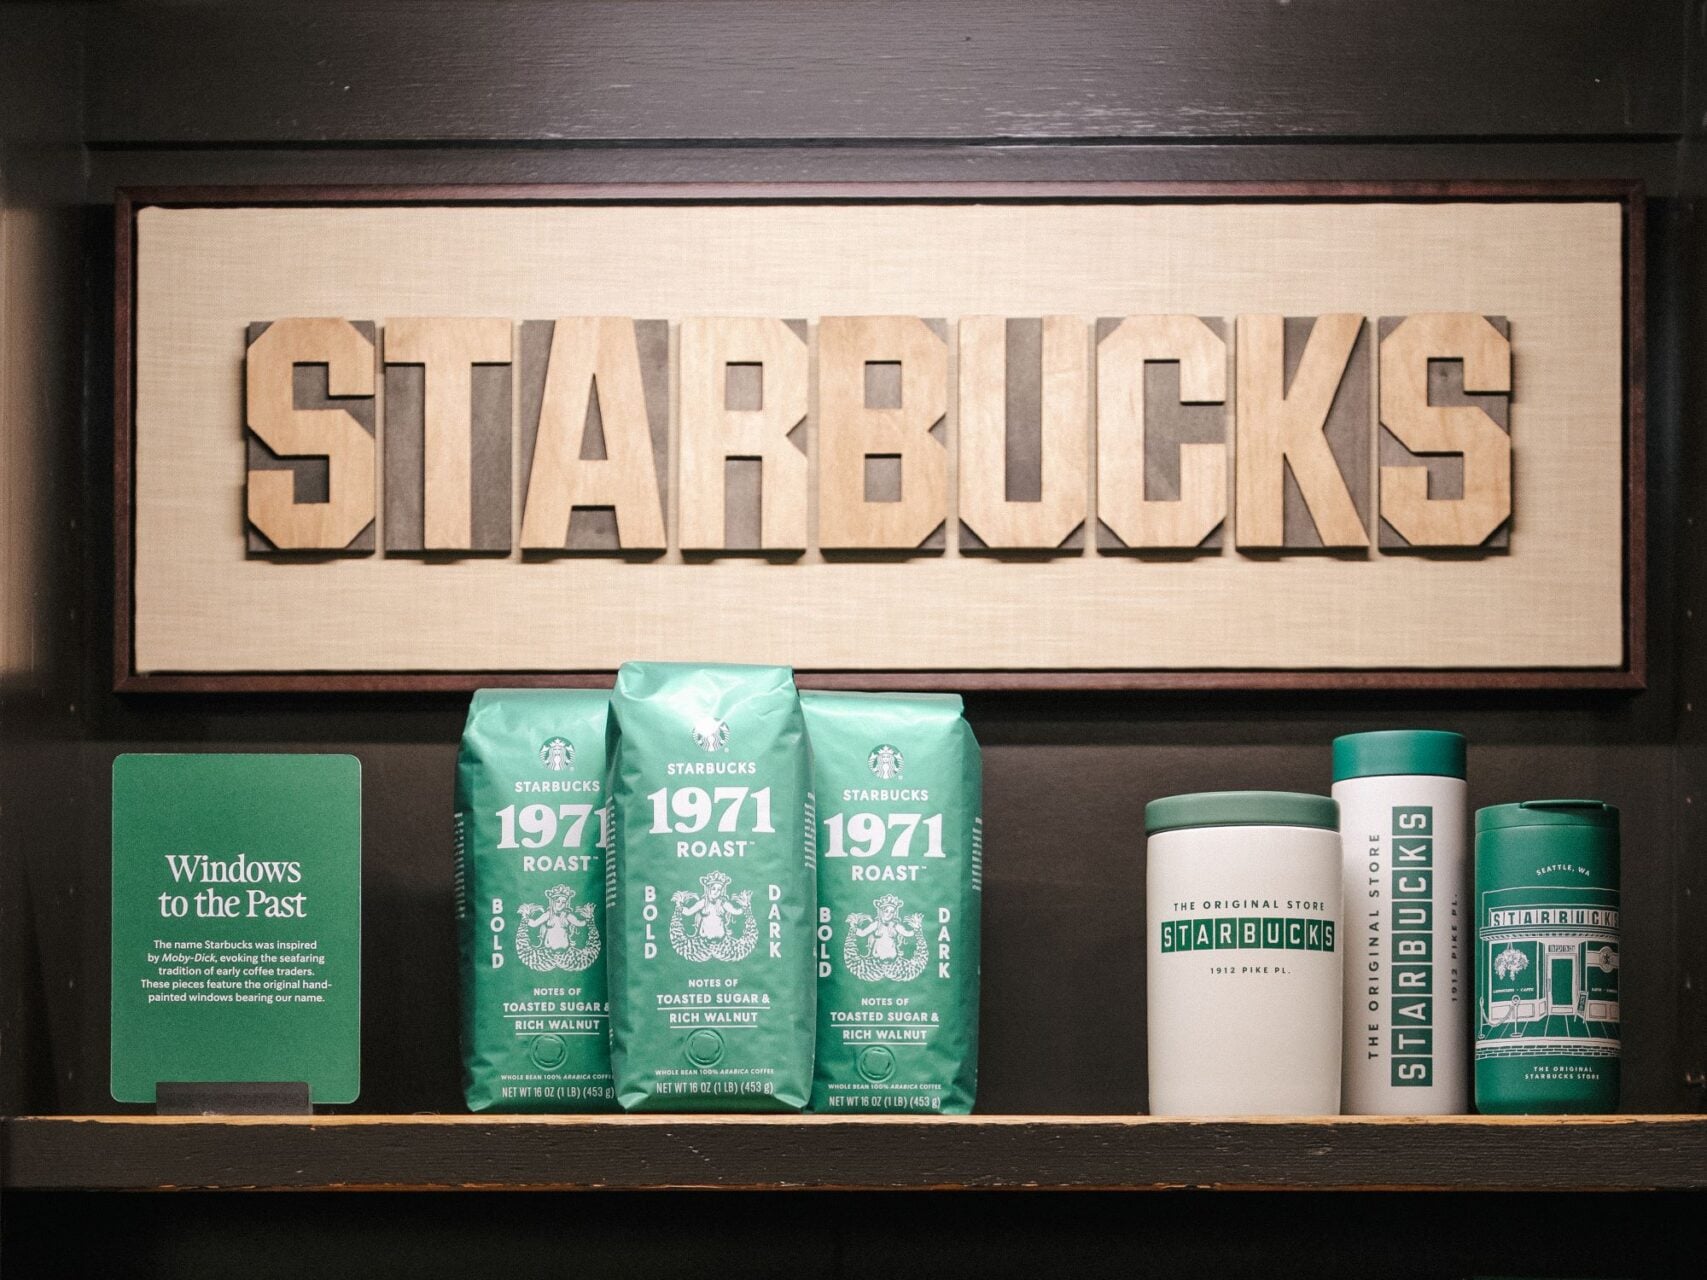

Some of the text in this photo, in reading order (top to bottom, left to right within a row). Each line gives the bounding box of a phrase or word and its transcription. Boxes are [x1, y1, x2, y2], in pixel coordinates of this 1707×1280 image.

[246, 315, 1511, 551] STARBUCKS
[668, 762, 756, 775] STARBUCKS
[515, 780, 600, 793] STARBUCKS
[843, 789, 928, 801] STARBUCKS
[648, 787, 775, 833] 1971
[824, 813, 945, 857] 1971
[165, 853, 301, 883] Windows
[158, 888, 307, 918] to the Past
[1174, 900, 1324, 912] THE ORIGINAL STORE
[643, 885, 658, 959] BOLD
[768, 884, 781, 958] DARK
[490, 898, 505, 969] BOLD
[1164, 921, 1332, 949] STARBUCKS
[153, 940, 172, 949] The
[204, 940, 253, 949] Starbucks
[277, 940, 317, 951] inspired
[816, 907, 833, 977] BOLD
[938, 907, 950, 978] DARK
[1368, 833, 1379, 1060] THE ORIGINAL STORE
[1398, 813, 1426, 1079] STARBUCKS
[147, 953, 325, 965] by Moby-Dick, evoking the seafaring
[158, 966, 315, 977] tradition of early coffee traders.
[1242, 966, 1268, 974] PIKE
[141, 979, 332, 991] These pieces feature the original hand-
[688, 979, 738, 988] NOTES OF
[148, 992, 187, 1003] painted
[188, 993, 233, 1002] windows
[235, 993, 273, 1004] bearing
[657, 993, 770, 1004] TOASTED SUGAR &
[861, 998, 909, 1006] NOTES OF
[670, 1012, 758, 1023] RICH WALNUT
[831, 1011, 939, 1022] TOASTED SUGAR &
[843, 1029, 928, 1040] RICH WALNUT
